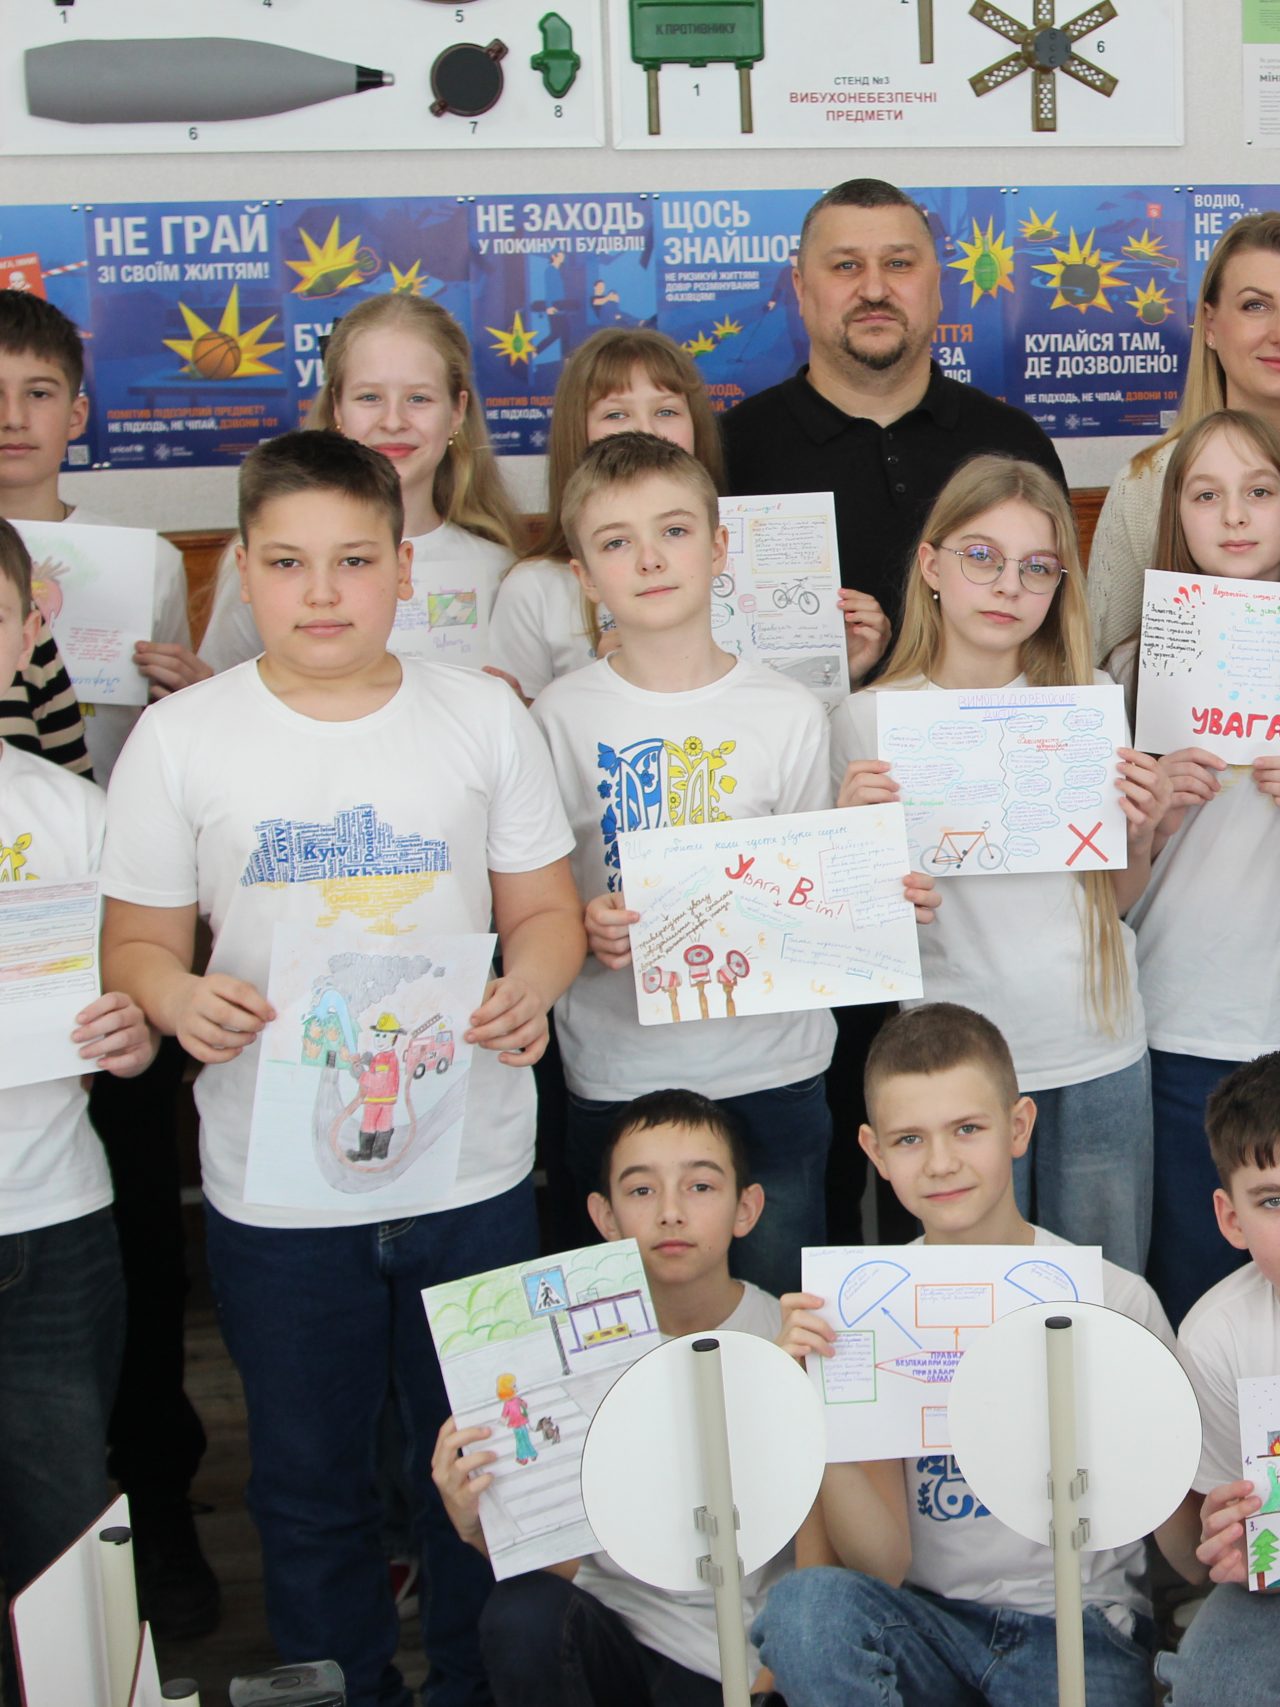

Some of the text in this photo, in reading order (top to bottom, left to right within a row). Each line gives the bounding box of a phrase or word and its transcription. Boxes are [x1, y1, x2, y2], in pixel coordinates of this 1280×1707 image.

[61, 11, 67, 23] 1
[455, 11, 464, 23] 5
[666, 23, 736, 34] ПРОТИВНИКУ
[1097, 40, 1105, 53] 6
[834, 76, 890, 87] СТЕНД №3
[694, 84, 700, 96] 1
[789, 92, 937, 104] ВИБУХОНЕБЕЗПЕЧНІ
[554, 106, 563, 118] 8
[826, 109, 903, 122] ПРЕДМЕТИ
[188, 128, 198, 140] 6
[469, 122, 478, 134] 7
[1194, 194, 1244, 209] ВОДІЮ,
[477, 202, 644, 235] НЕ ЗАХОДЬ
[662, 200, 750, 233] ЩОСЬ
[1195, 212, 1223, 234] НЕ
[94, 205, 268, 256] НЕ ГРАЙ
[478, 236, 645, 255] У ПОКИНУТІ БУДІВЛІ!
[98, 262, 270, 283] ЗІ СВОЇМ ЖИТТЯМ!
[1025, 329, 1166, 354] КУПАЙСЯ ТАМ,
[939, 346, 966, 366] ЗА
[1025, 354, 1178, 379] ДЕ ДОЗВОЛЕНО!
[1025, 390, 1177, 404] НЕ ПІДХОДЬ, НЕ ЧІПАЙ, ДЗВОНИ 101
[364, 809, 373, 863] Donetsk
[276, 826, 288, 864] Lviv
[303, 842, 349, 863] Kyiv
